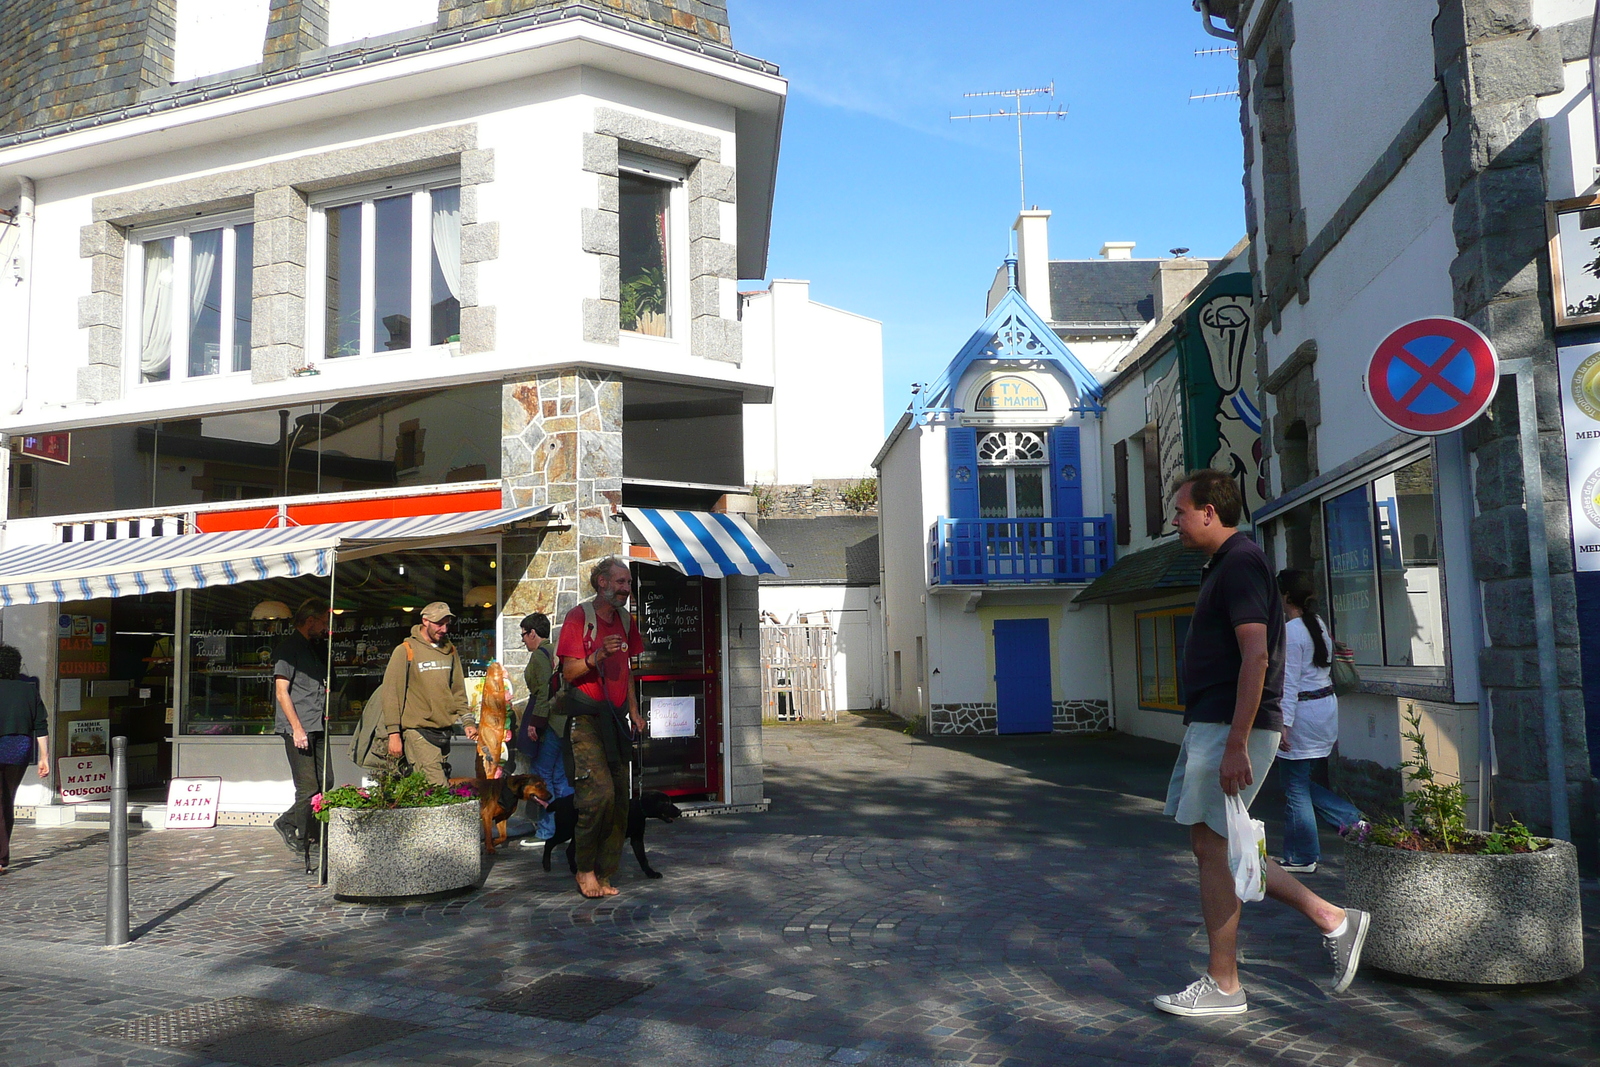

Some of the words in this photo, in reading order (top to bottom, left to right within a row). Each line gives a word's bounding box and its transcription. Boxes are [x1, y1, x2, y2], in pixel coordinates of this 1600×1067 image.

[1000, 383, 1021, 394] TY
[983, 397, 999, 406] ME
[1004, 396, 1039, 406] MAMM
[1332, 590, 1370, 612] GALETTES
[60, 638, 93, 651] PLATS
[59, 661, 108, 674] CUISINES
[77, 761, 93, 769] CE
[67, 773, 107, 783] MATIN
[62, 785, 112, 797] COUSCOUS
[187, 784, 202, 792] CE
[174, 798, 211, 807] MATIN
[169, 813, 211, 821] PAELLA
